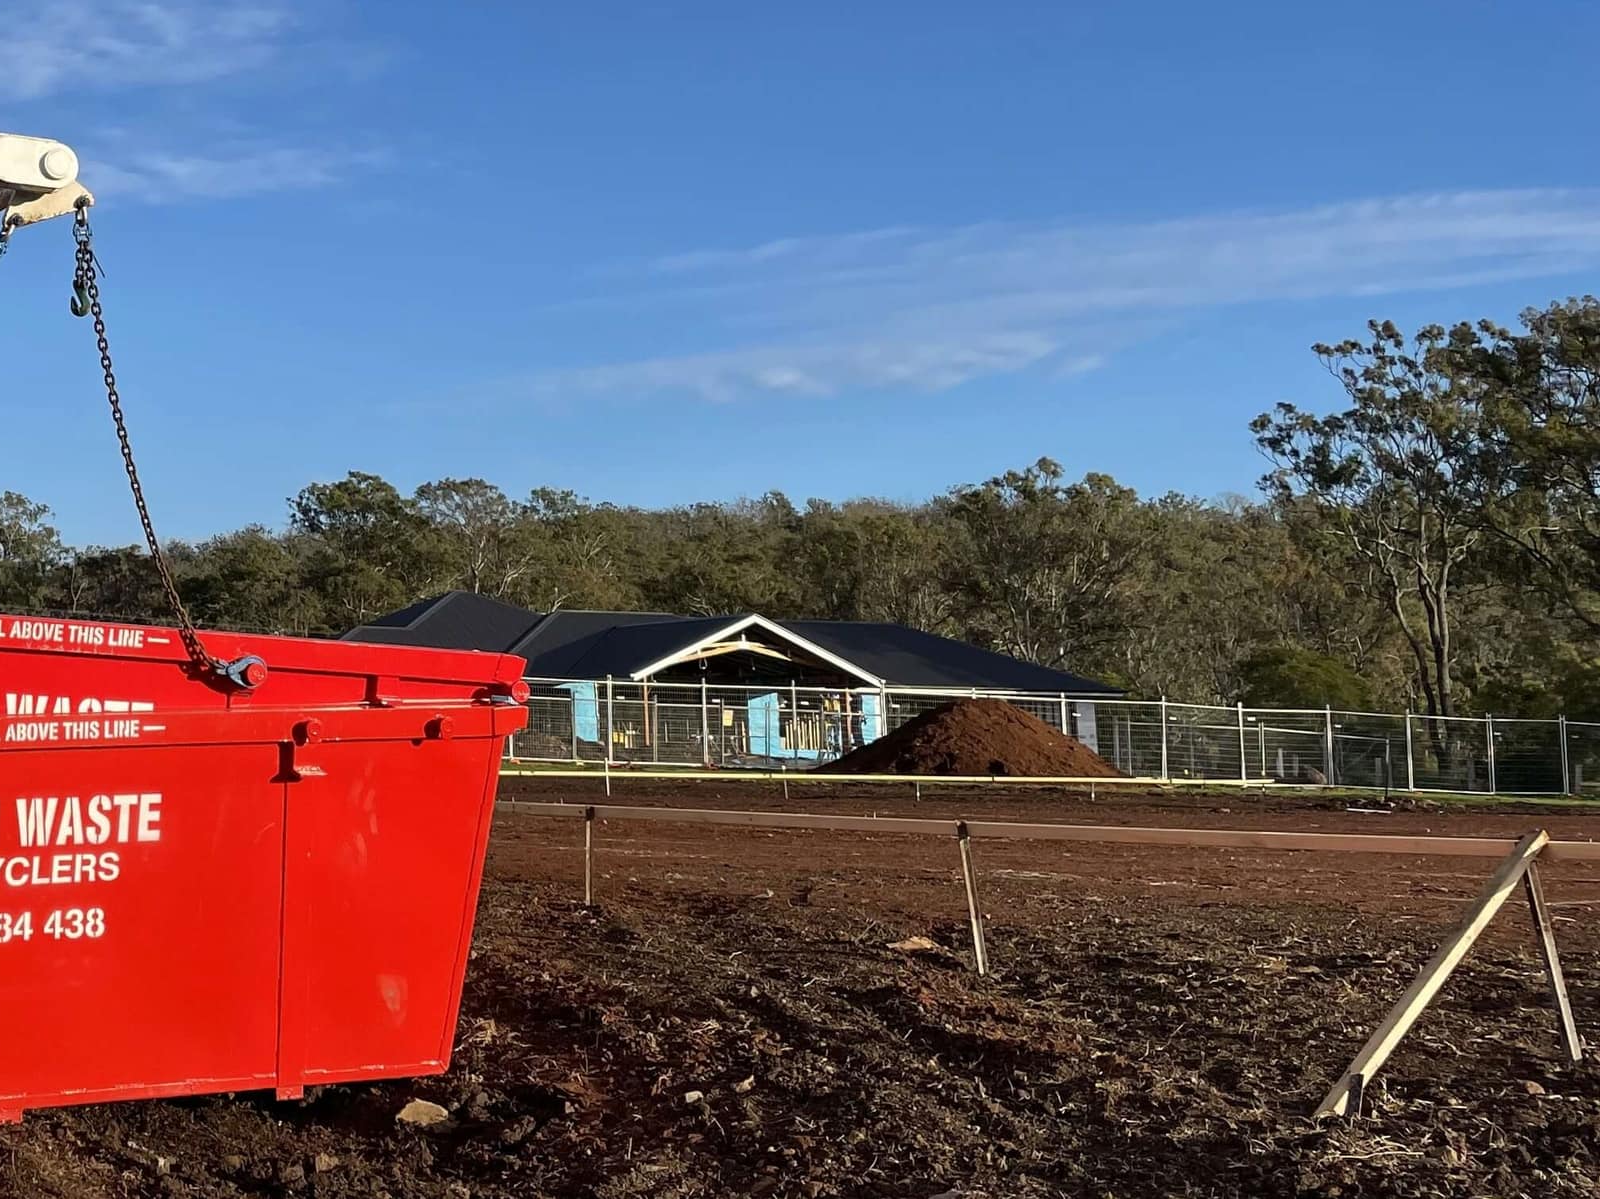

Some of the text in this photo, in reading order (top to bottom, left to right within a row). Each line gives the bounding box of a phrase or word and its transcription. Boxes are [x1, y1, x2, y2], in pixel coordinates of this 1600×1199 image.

[9, 620, 65, 642] ABOVE
[68, 624, 105, 646] THIS
[107, 628, 145, 648] LINE
[4, 721, 59, 742] ABOVE
[62, 720, 100, 740] THIS
[103, 719, 140, 739] LINE
[15, 793, 162, 847] WASTE
[43, 907, 105, 939] 438
